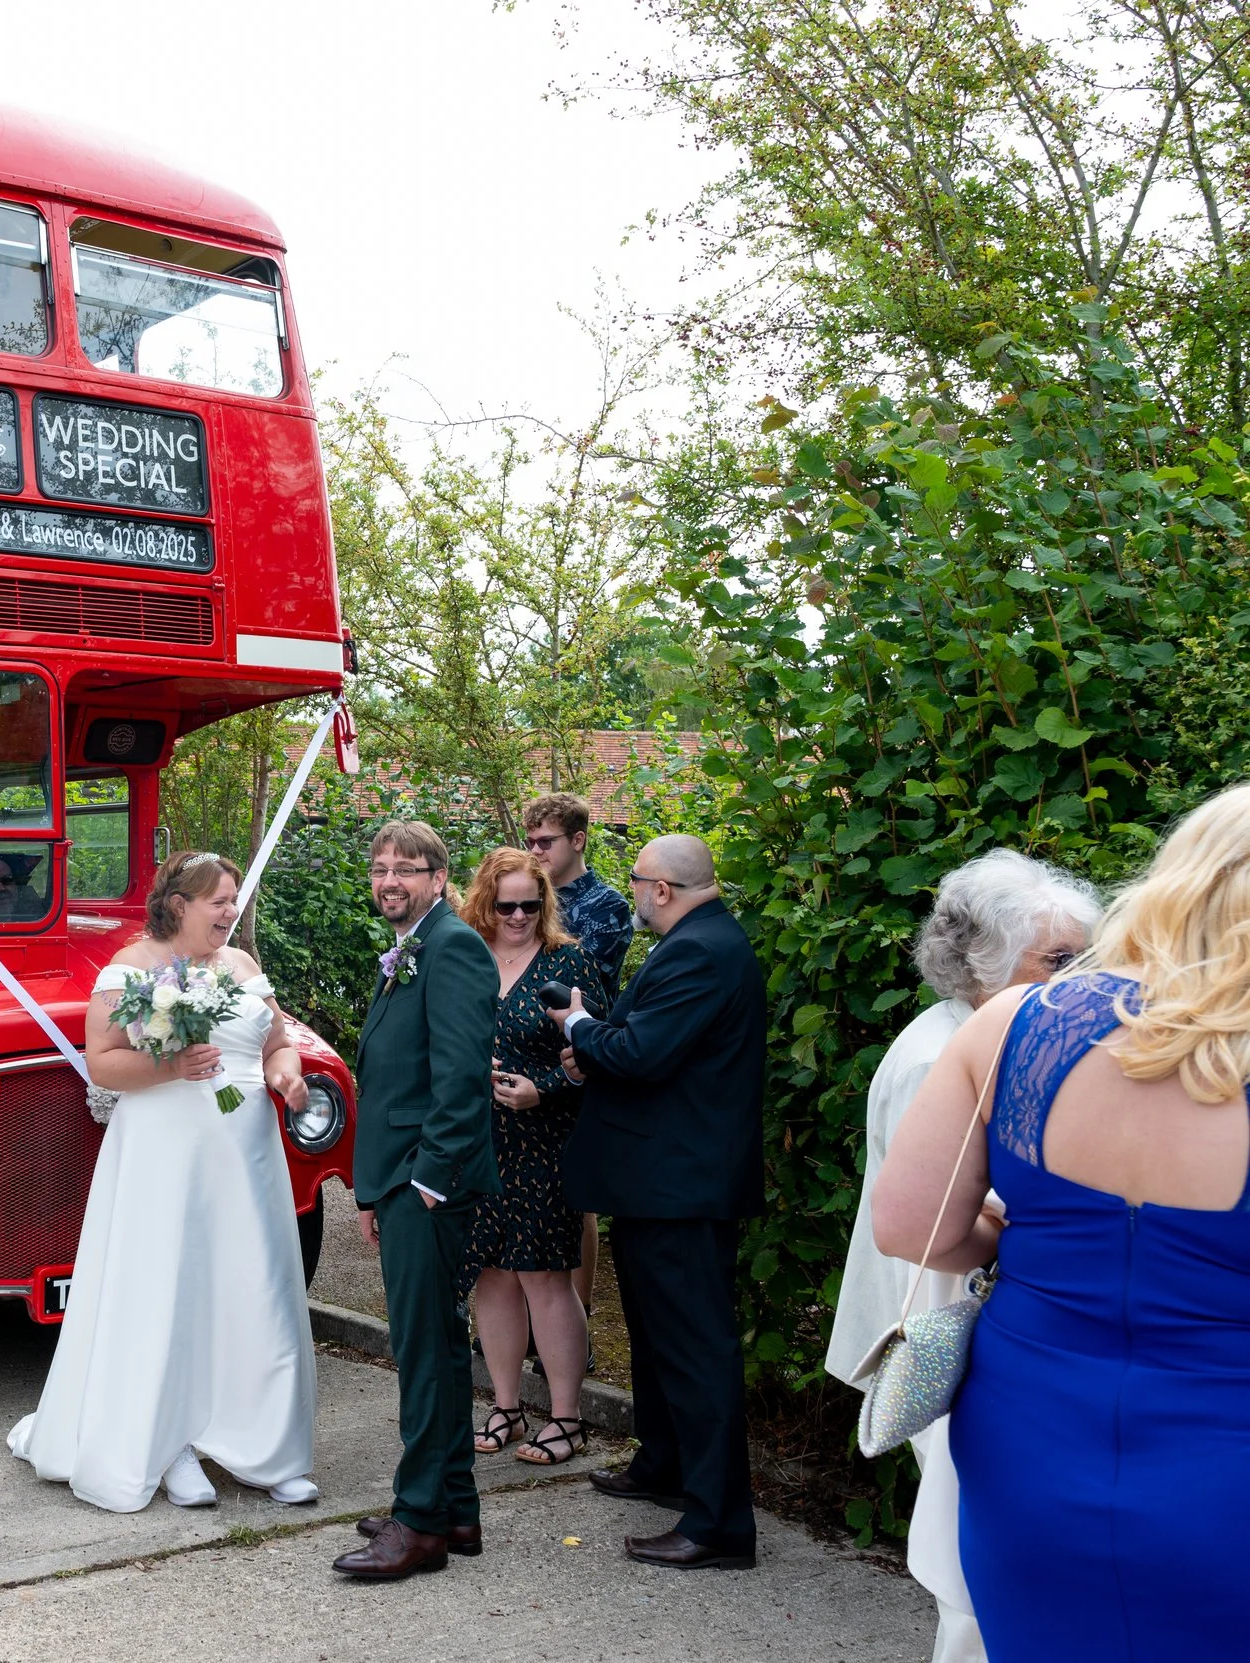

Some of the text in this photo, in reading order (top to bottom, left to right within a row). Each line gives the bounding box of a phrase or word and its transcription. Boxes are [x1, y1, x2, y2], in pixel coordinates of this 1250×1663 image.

[40, 413, 199, 462] WEDDING
[59, 450, 187, 494] SPECIAL
[1, 511, 16, 540] &
[21, 514, 105, 551] Lawrence
[111, 526, 197, 563] 02.08.2025
